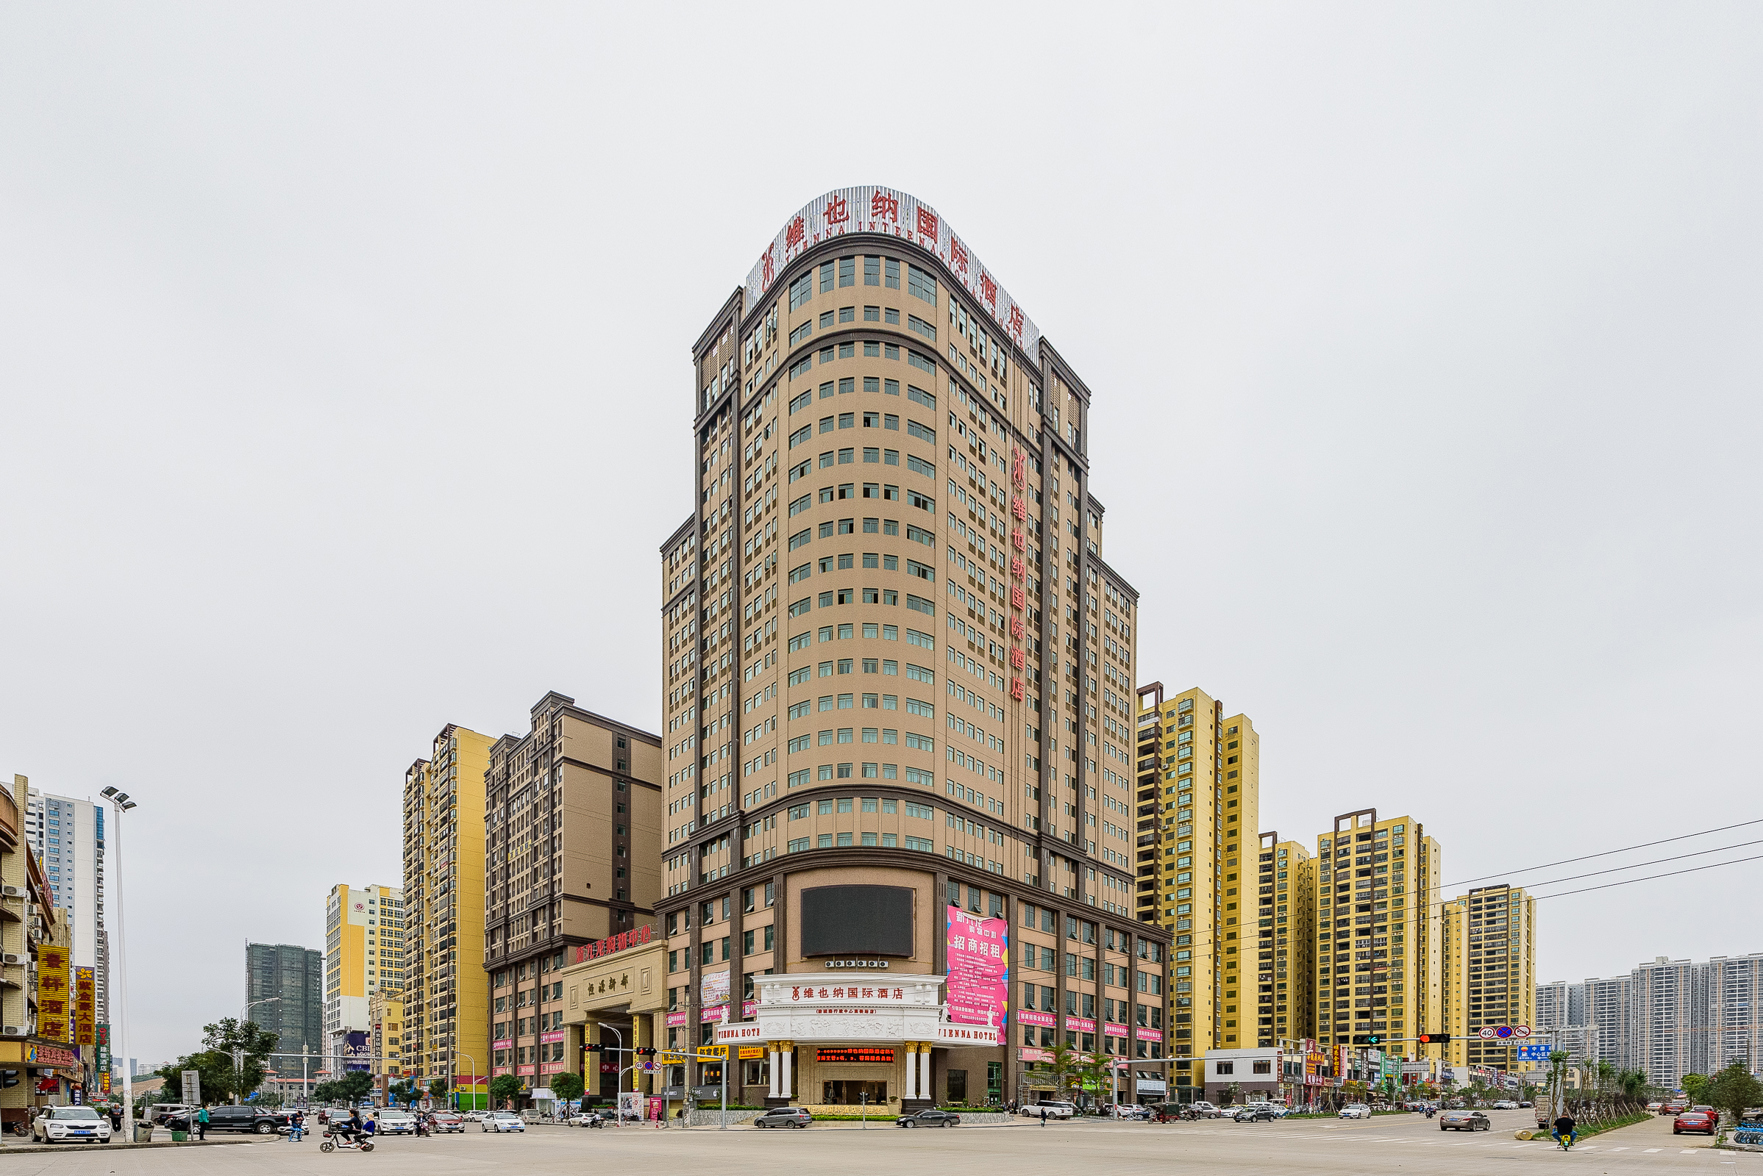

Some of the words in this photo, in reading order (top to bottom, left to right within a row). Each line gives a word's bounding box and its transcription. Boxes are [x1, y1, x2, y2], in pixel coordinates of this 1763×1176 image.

[786, 190, 1024, 338] 维也纳国际酒店
[1010, 493, 1026, 702] 维也纳国际酒店
[954, 935, 1000, 958] 招商招租
[803, 987, 903, 1000] 维也纳国际酒店
[973, 1031, 997, 1041] HOTEL
